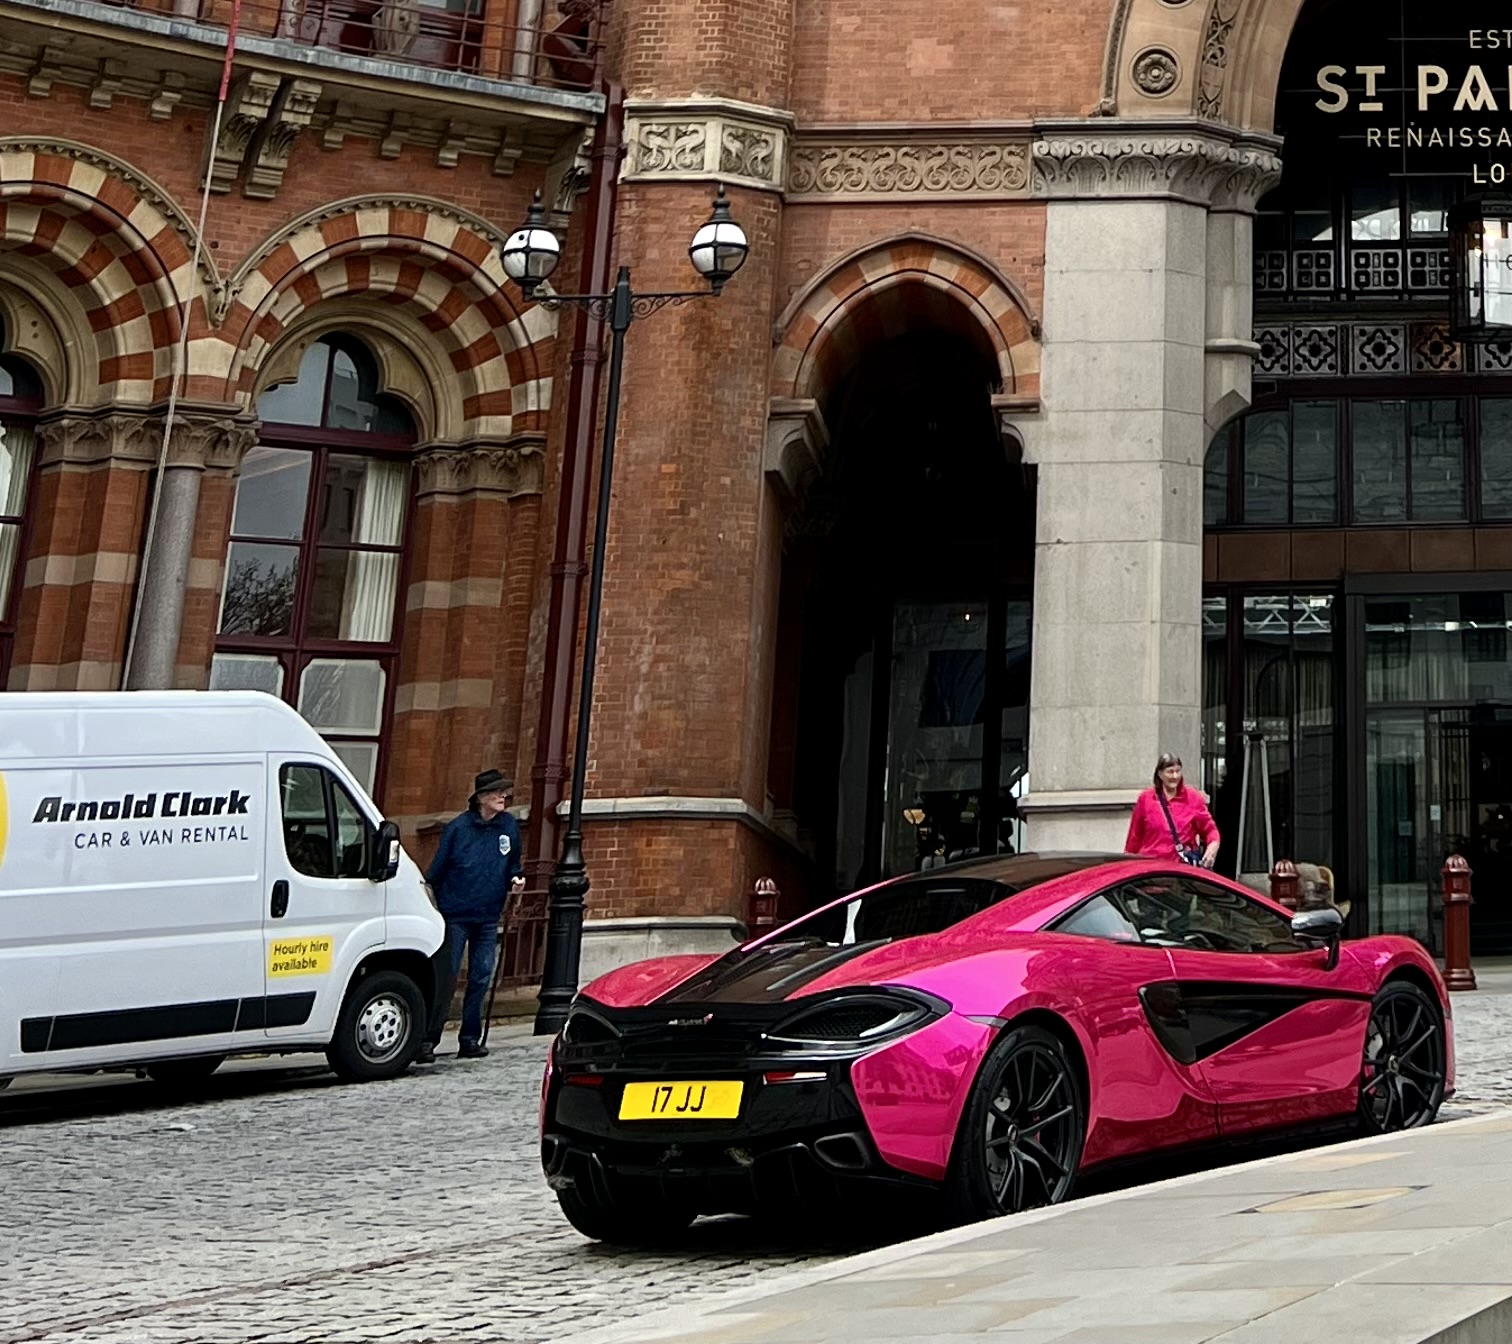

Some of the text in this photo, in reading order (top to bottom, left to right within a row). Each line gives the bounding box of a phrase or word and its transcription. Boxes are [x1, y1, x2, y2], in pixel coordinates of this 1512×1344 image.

[1315, 64, 1386, 113] ST
[32, 790, 251, 823] Arnold Clark
[74, 825, 249, 849] CAR & VAN RENTAL
[273, 940, 329, 956] Hourly hire
[272, 957, 318, 972] available
[651, 1086, 707, 1113] 17 JJ
